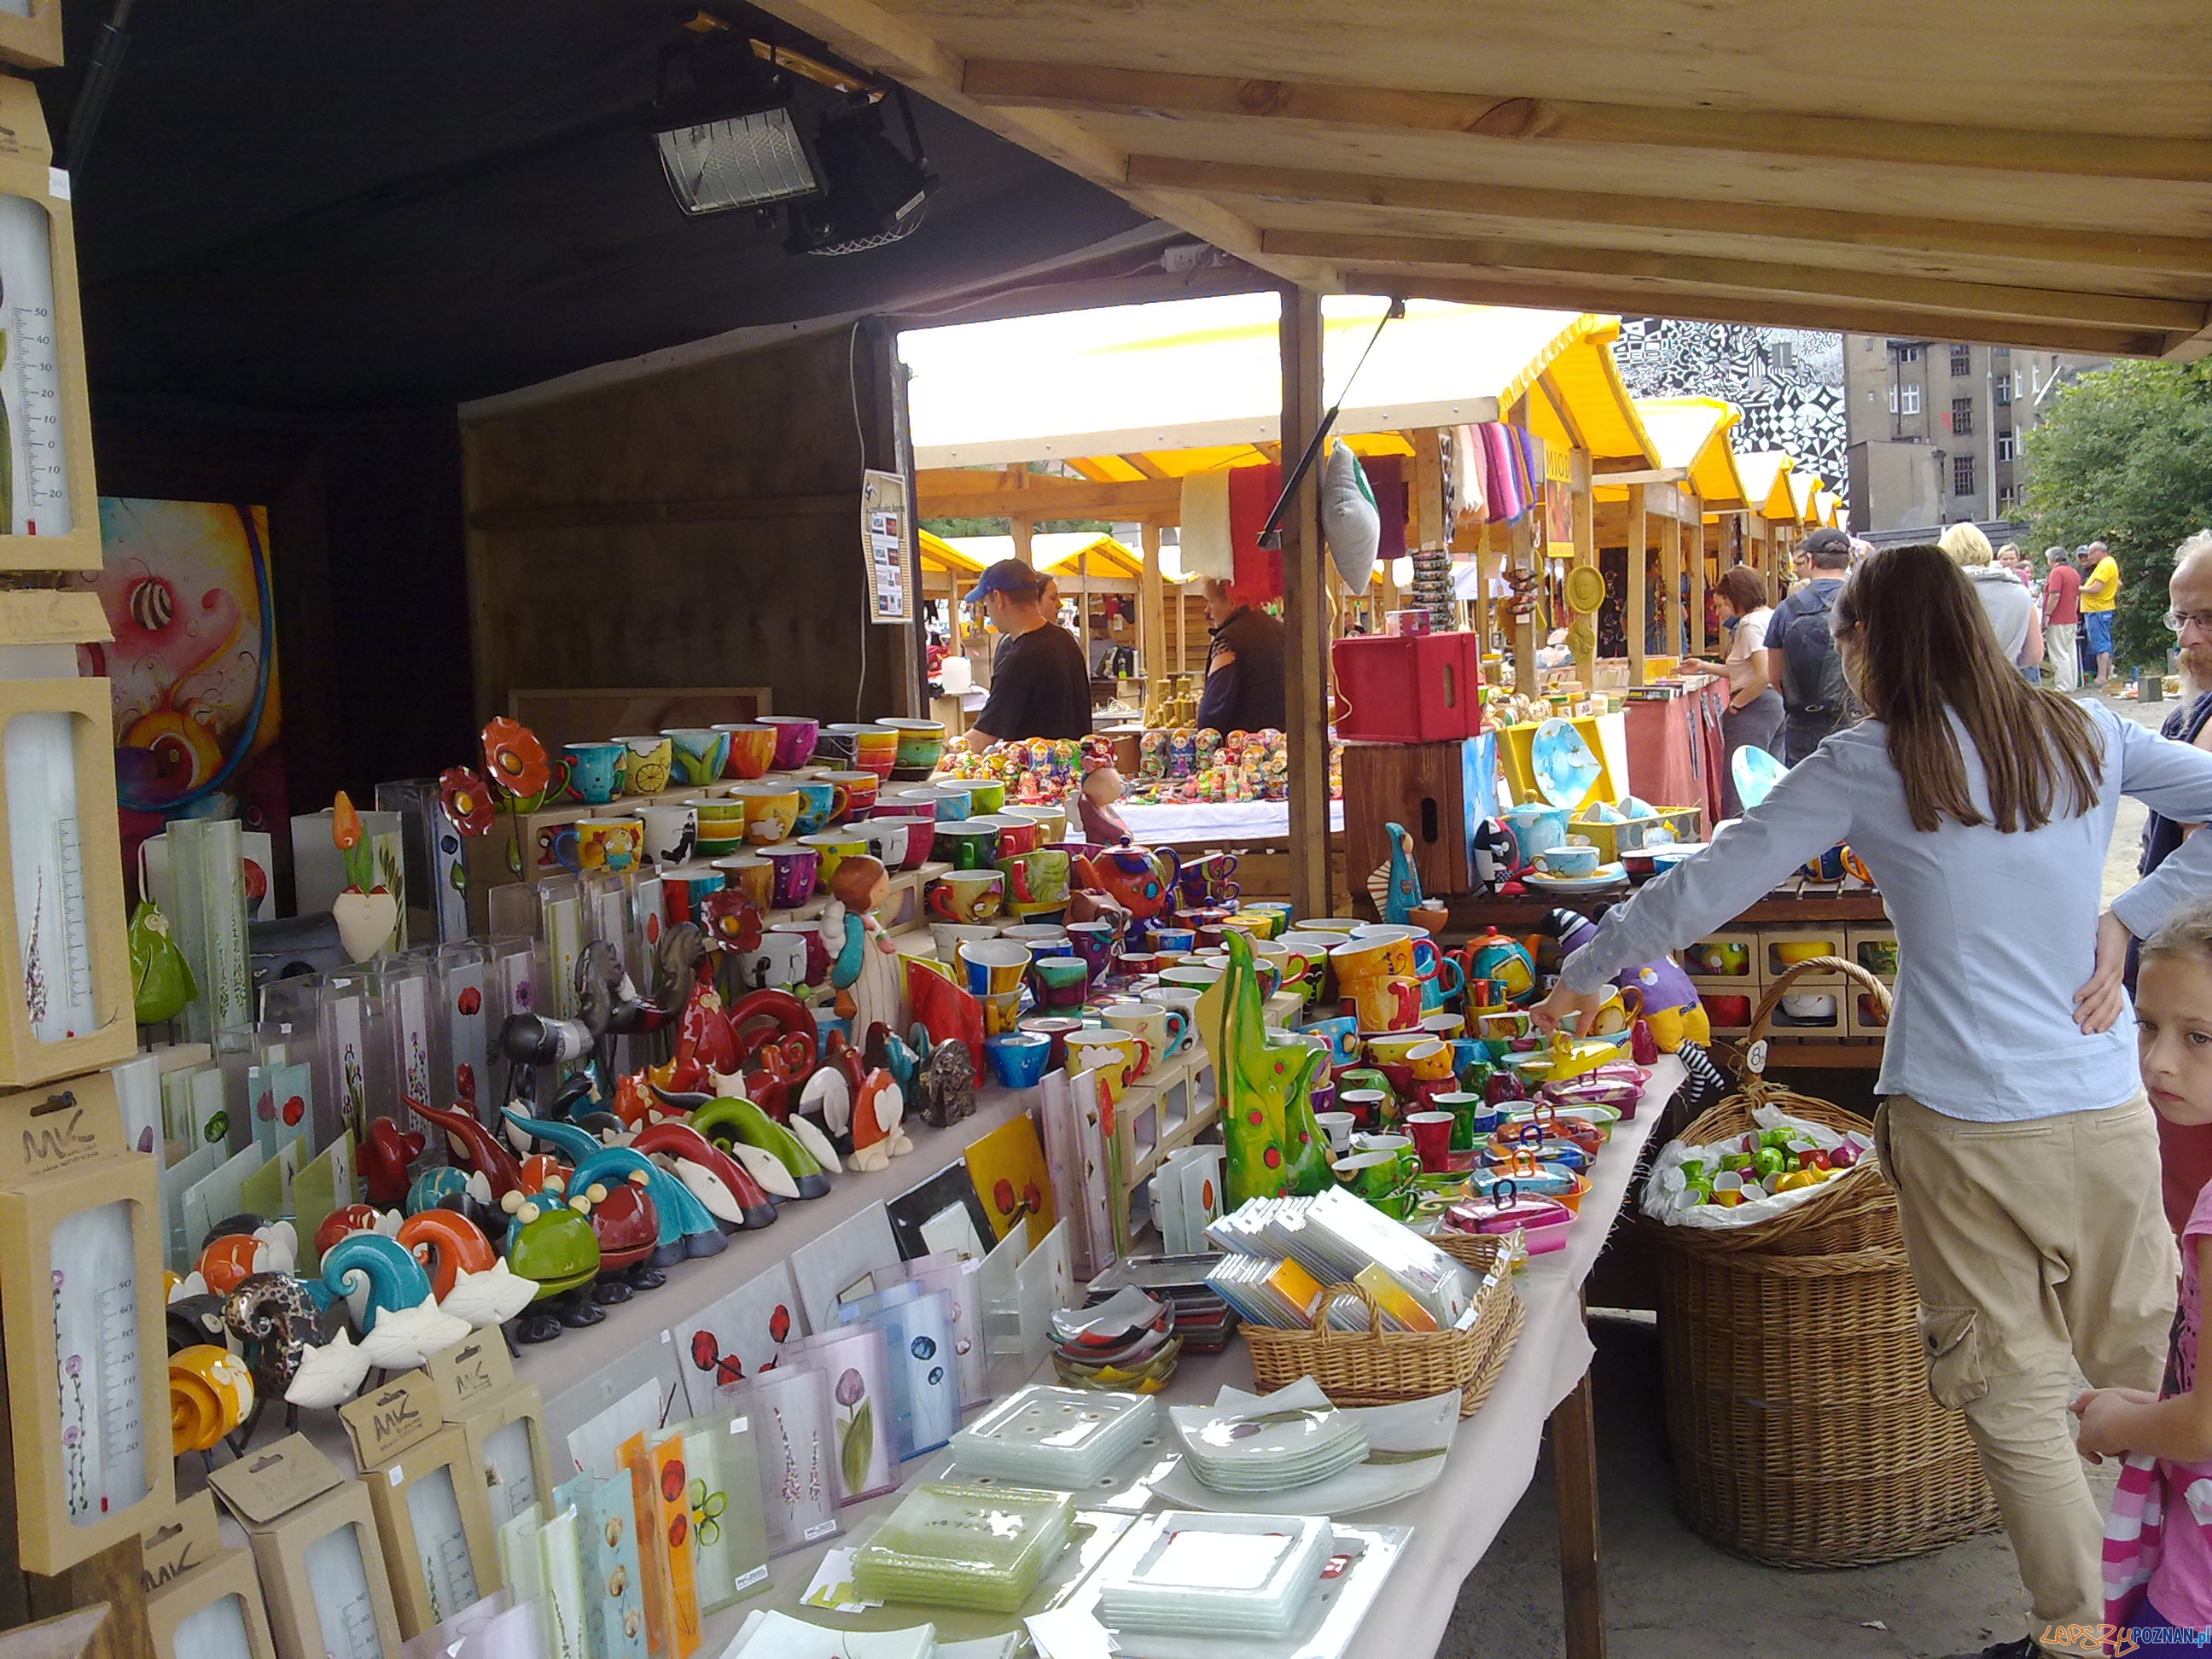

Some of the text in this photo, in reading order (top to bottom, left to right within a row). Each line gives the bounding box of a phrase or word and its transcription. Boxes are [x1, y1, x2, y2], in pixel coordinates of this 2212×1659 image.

[34, 307, 48, 317] 50
[36, 335, 49, 345] 40
[38, 363, 52, 372] 30
[41, 389, 55, 399] 20
[44, 416, 56, 424] 10
[48, 465, 61, 474] 10
[49, 490, 62, 498] 20
[23, 1109, 95, 1164] MK
[118, 1279, 131, 1289] 50
[121, 1328, 134, 1339] 30
[121, 1352, 135, 1363] 20
[123, 1375, 136, 1387] 10
[126, 1399, 134, 1408] 0
[374, 1393, 419, 1441] MK
[124, 1419, 137, 1431] 10
[125, 1441, 138, 1452] 20
[139, 1541, 201, 1592] MK
